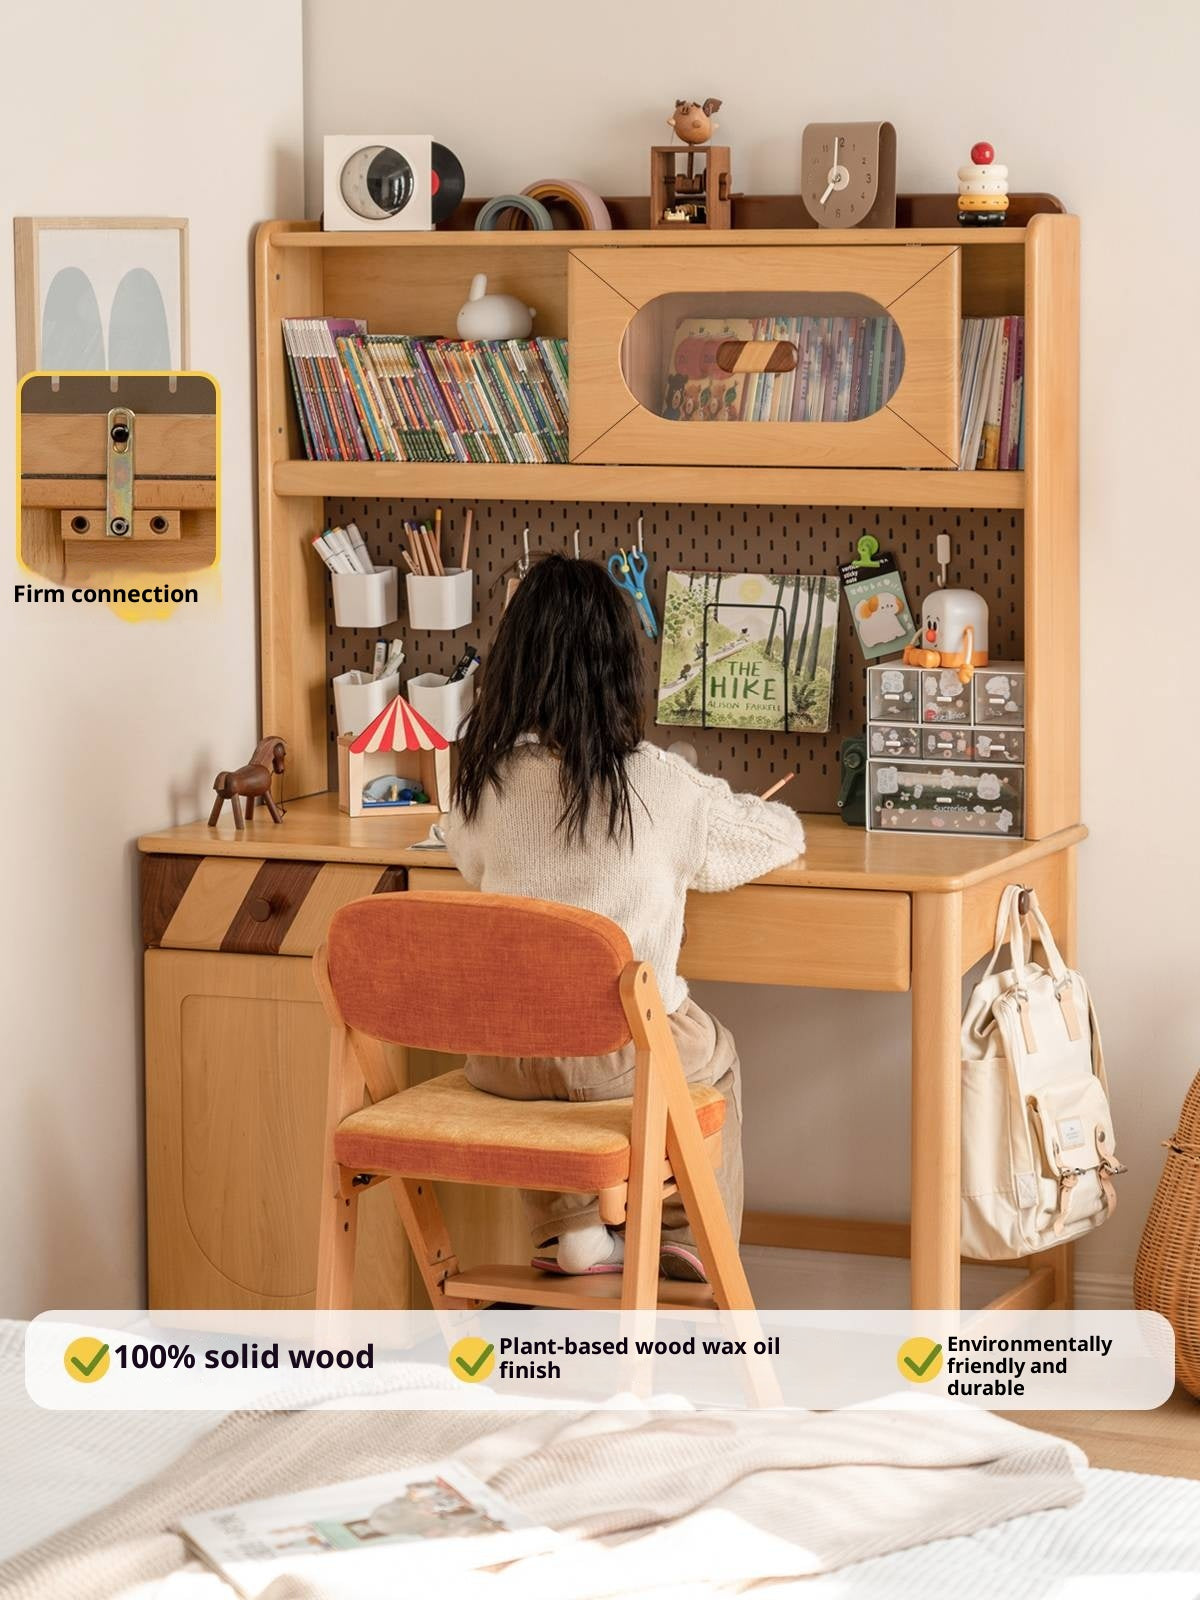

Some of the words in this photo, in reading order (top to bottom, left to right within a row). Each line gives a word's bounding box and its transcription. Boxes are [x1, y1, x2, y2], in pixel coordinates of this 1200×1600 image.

[866, 172, 872, 184] 3
[728, 661, 762, 677] THE
[711, 676, 776, 700] HIKE
[708, 700, 740, 709] ALISON
[745, 702, 781, 712] FARRELL
